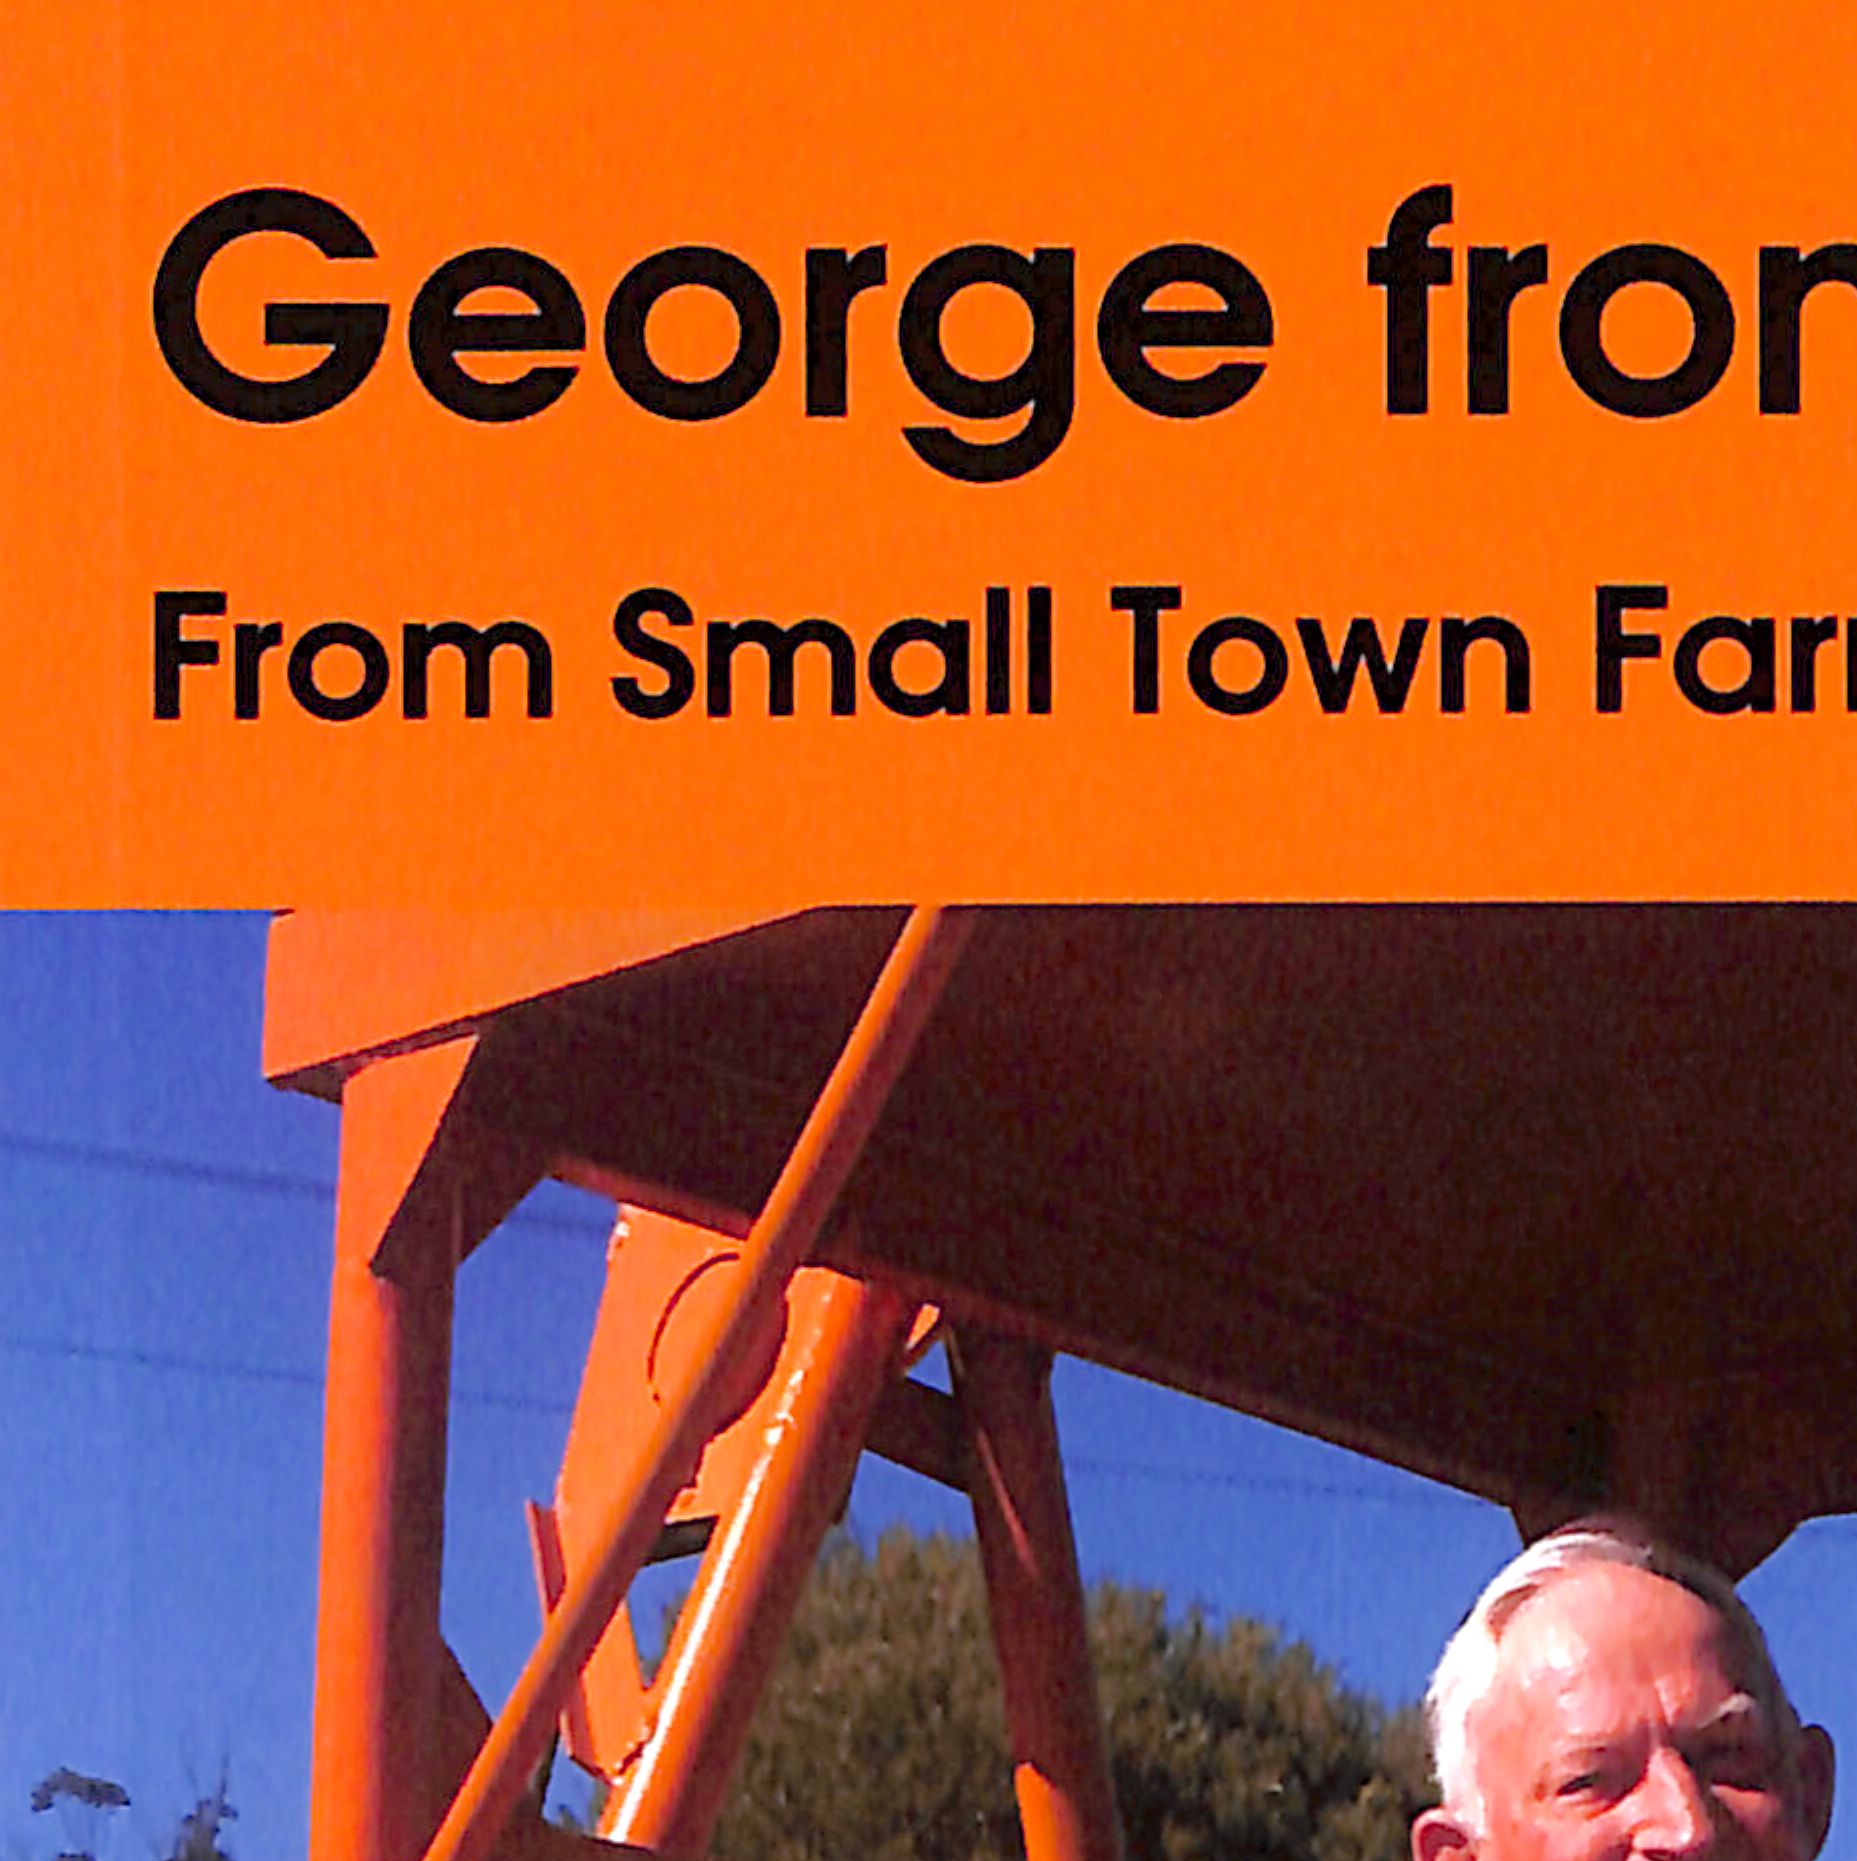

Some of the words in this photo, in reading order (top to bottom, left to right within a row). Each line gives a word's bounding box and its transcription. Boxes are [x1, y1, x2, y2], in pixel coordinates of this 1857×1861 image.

[151, 187, 1275, 484] George
[153, 589, 554, 722] From
[610, 585, 1053, 721] Small
[1109, 587, 1531, 717] Town
